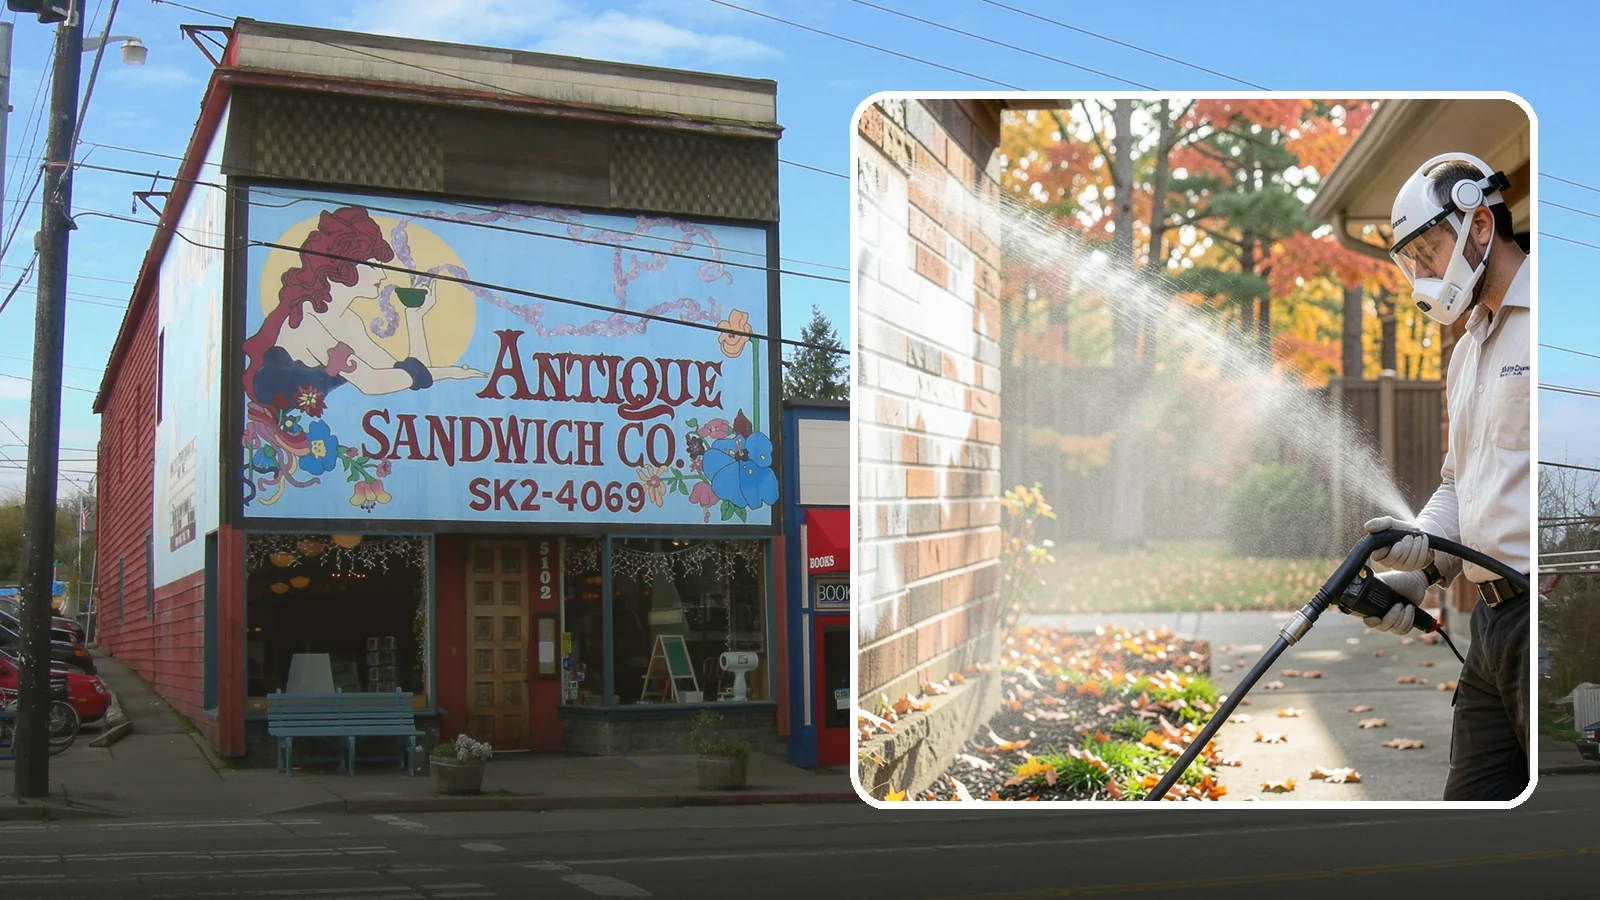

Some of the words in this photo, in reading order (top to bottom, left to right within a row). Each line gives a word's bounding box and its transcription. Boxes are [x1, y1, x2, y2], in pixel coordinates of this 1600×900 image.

[475, 329, 724, 421] ANTIQUE
[361, 409, 604, 467] SANDWICH
[617, 422, 685, 469] CO.
[468, 477, 646, 513] SK2-4069
[540, 541, 552, 600] 5102
[809, 555, 835, 569] BOOKS
